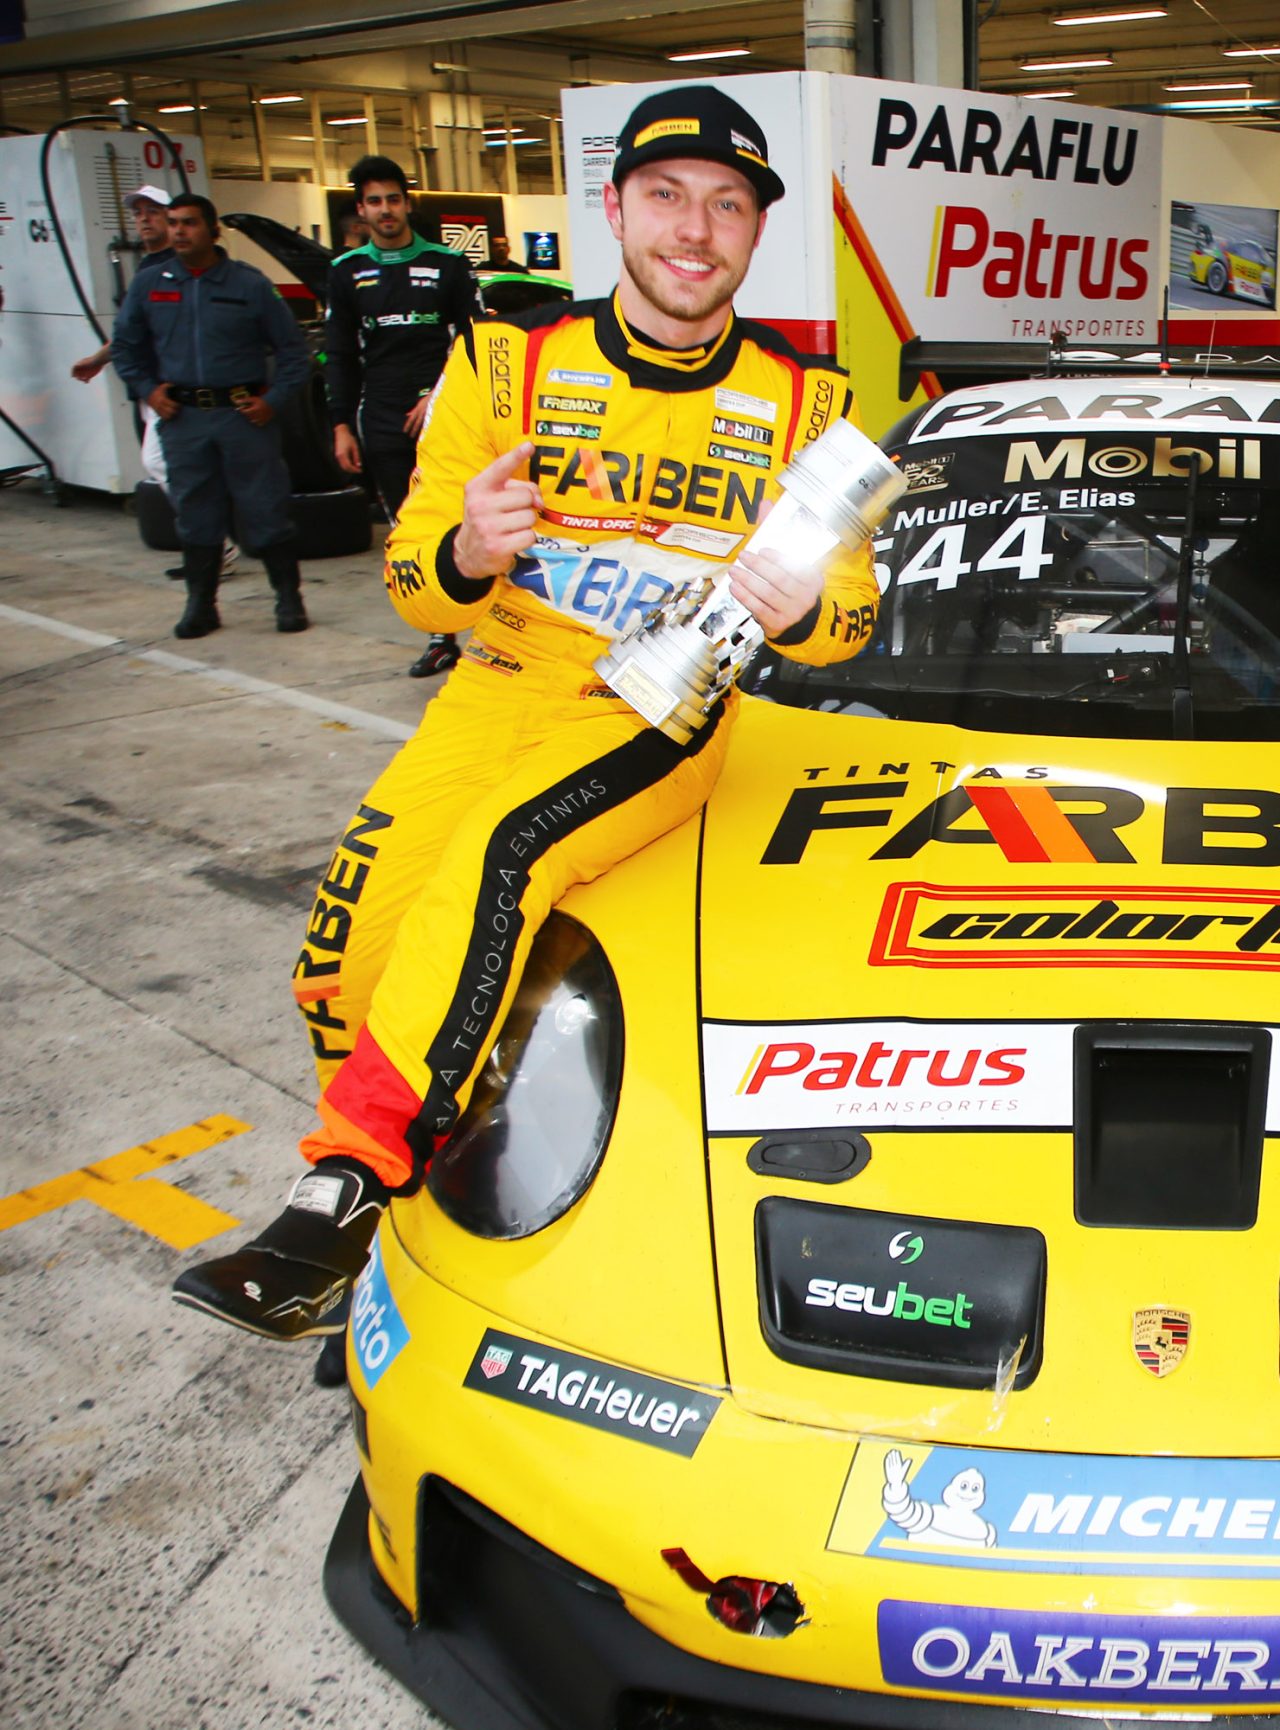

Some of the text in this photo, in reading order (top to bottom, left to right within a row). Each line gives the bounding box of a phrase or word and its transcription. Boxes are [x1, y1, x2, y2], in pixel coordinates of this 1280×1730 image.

[871, 98, 1139, 187] PARAFLU
[933, 205, 1149, 301] Patrus
[1011, 319, 1146, 338] TRANSPORTES
[487, 336, 512, 420] sparco
[543, 396, 603, 414] FREMAX
[803, 379, 833, 448] parco
[552, 423, 600, 438] seubet
[714, 417, 753, 440] Mobil
[723, 449, 771, 468] seubet
[1003, 437, 1262, 483] Mobil
[529, 443, 767, 525] FARBEN
[1059, 488, 1136, 510] Elias
[561, 515, 599, 529] TINTA
[572, 556, 690, 632] BR
[803, 761, 1049, 781] TINTAS
[292, 803, 394, 1060] FARBEN
[748, 1041, 1028, 1096] Patrus
[833, 1098, 1021, 1116] TRANSPORTES
[805, 1278, 974, 1330] seubet
[1135, 1308, 1191, 1319] PORSCHE
